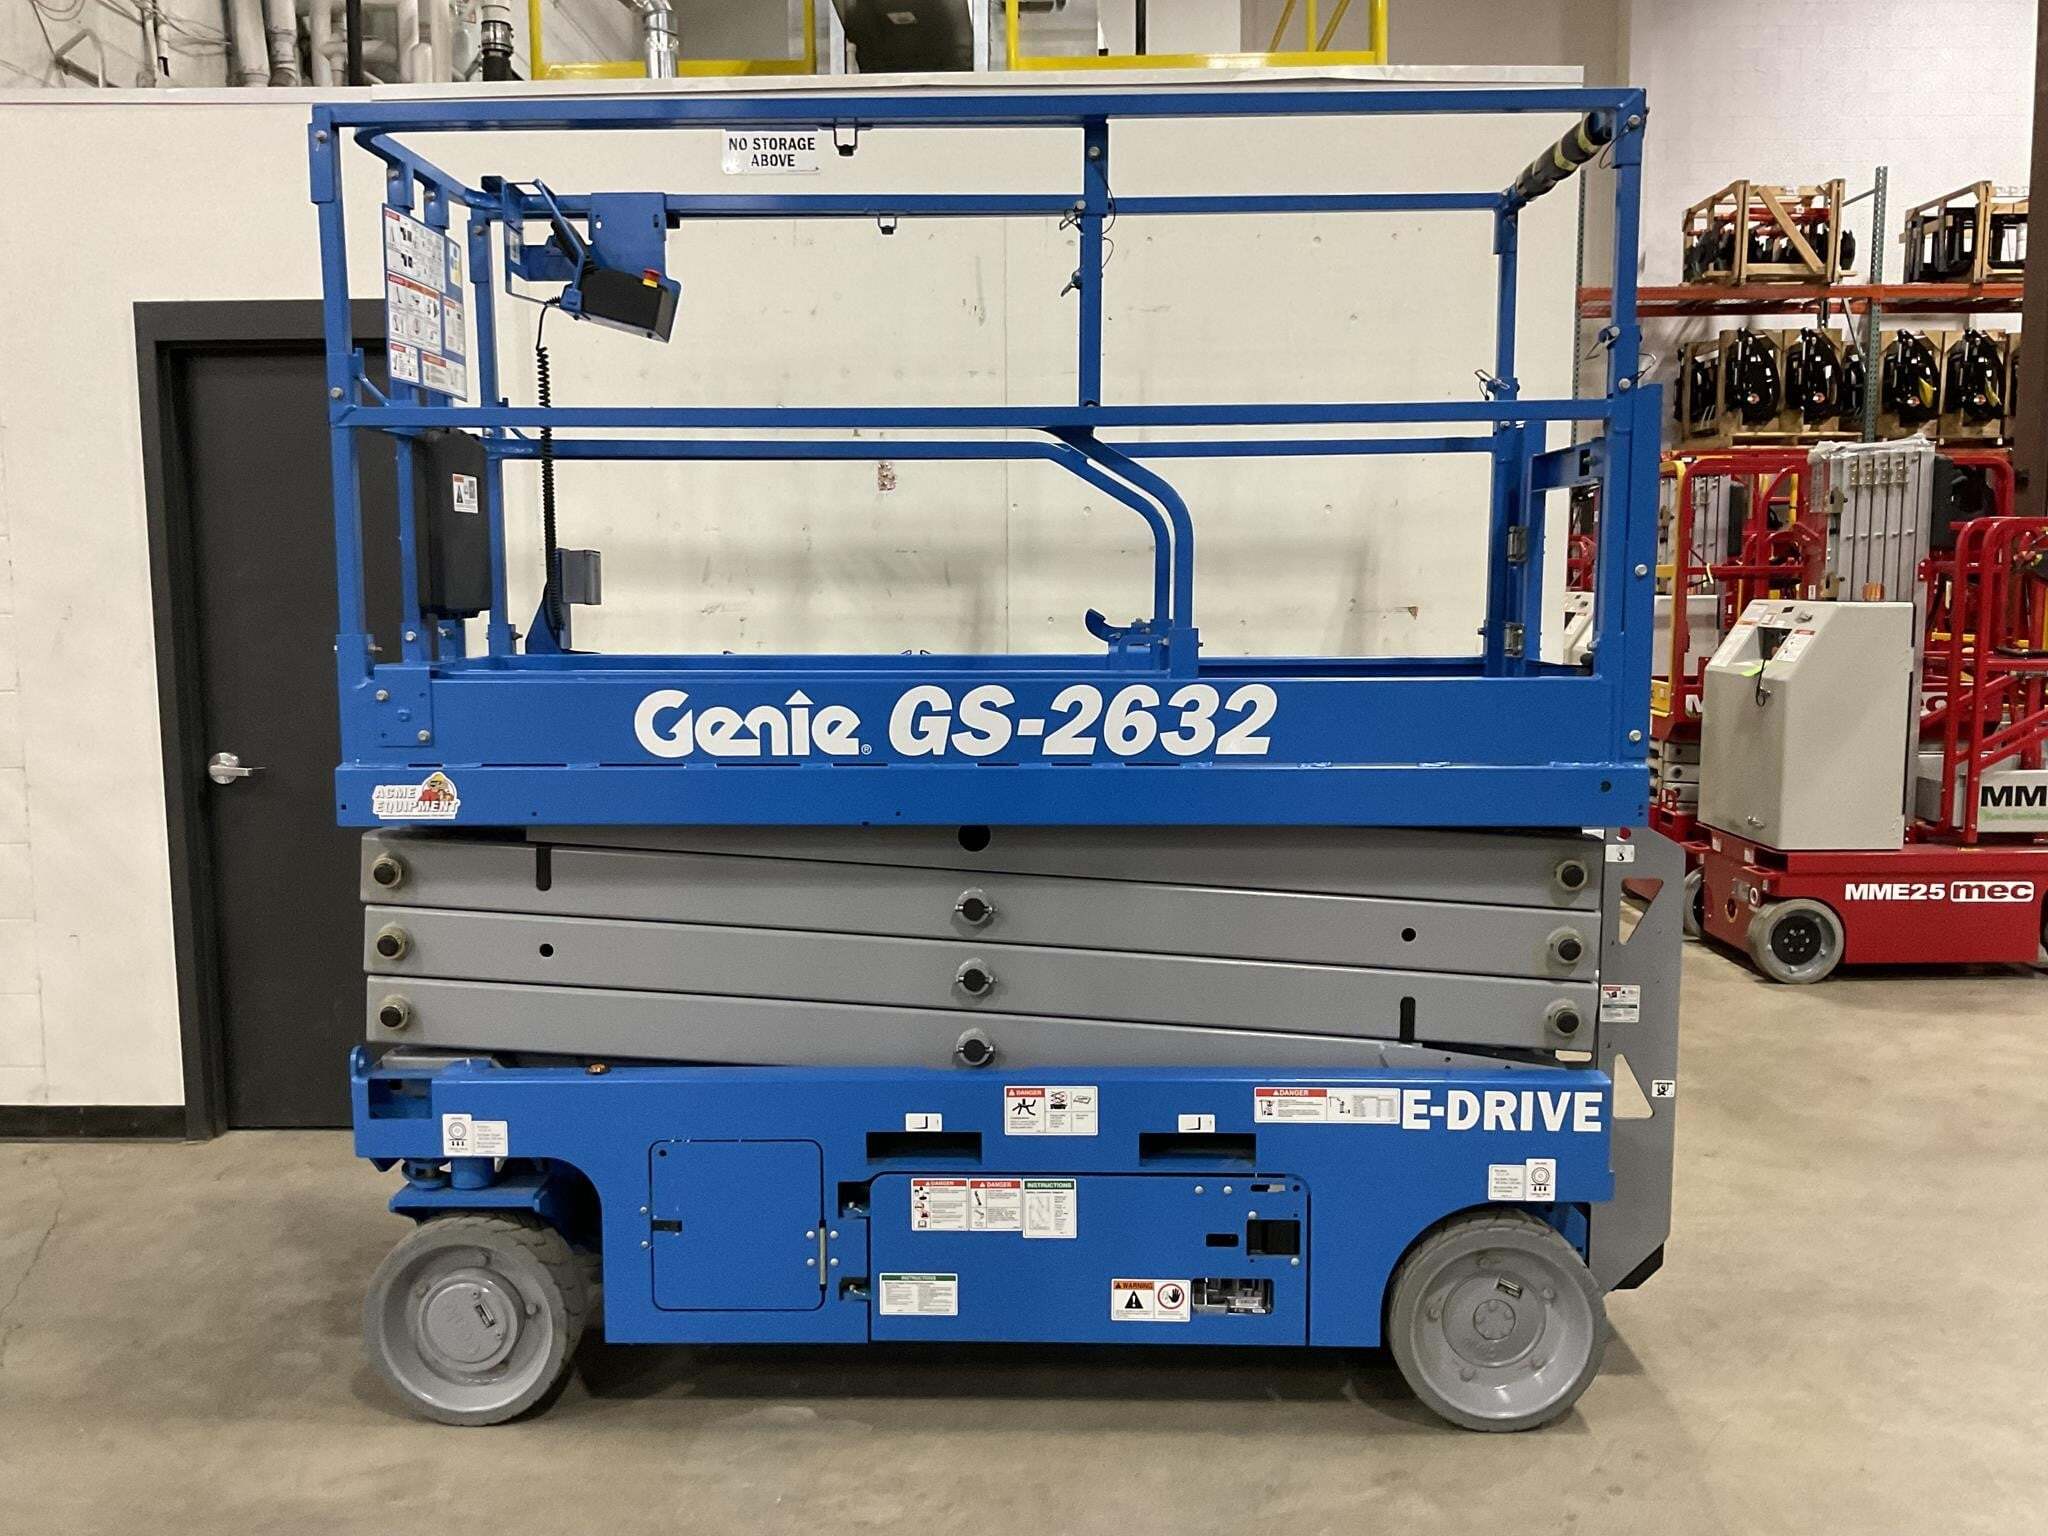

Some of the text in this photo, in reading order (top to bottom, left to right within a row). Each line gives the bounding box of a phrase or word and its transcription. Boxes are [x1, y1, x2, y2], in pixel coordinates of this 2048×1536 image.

[728, 137, 816, 151] NO STORAGE
[751, 154, 796, 167] ABOVE
[634, 684, 1279, 757] Genie GS-2632
[374, 786, 417, 799] ACME
[375, 799, 459, 814] EQUIPMENT
[1844, 883, 2033, 901] MME25 mec
[1402, 1088, 1603, 1132] E-DRIVE
[1026, 1181, 1073, 1189] INSTRUCTIONS
[1122, 1281, 1154, 1290] WARNING
